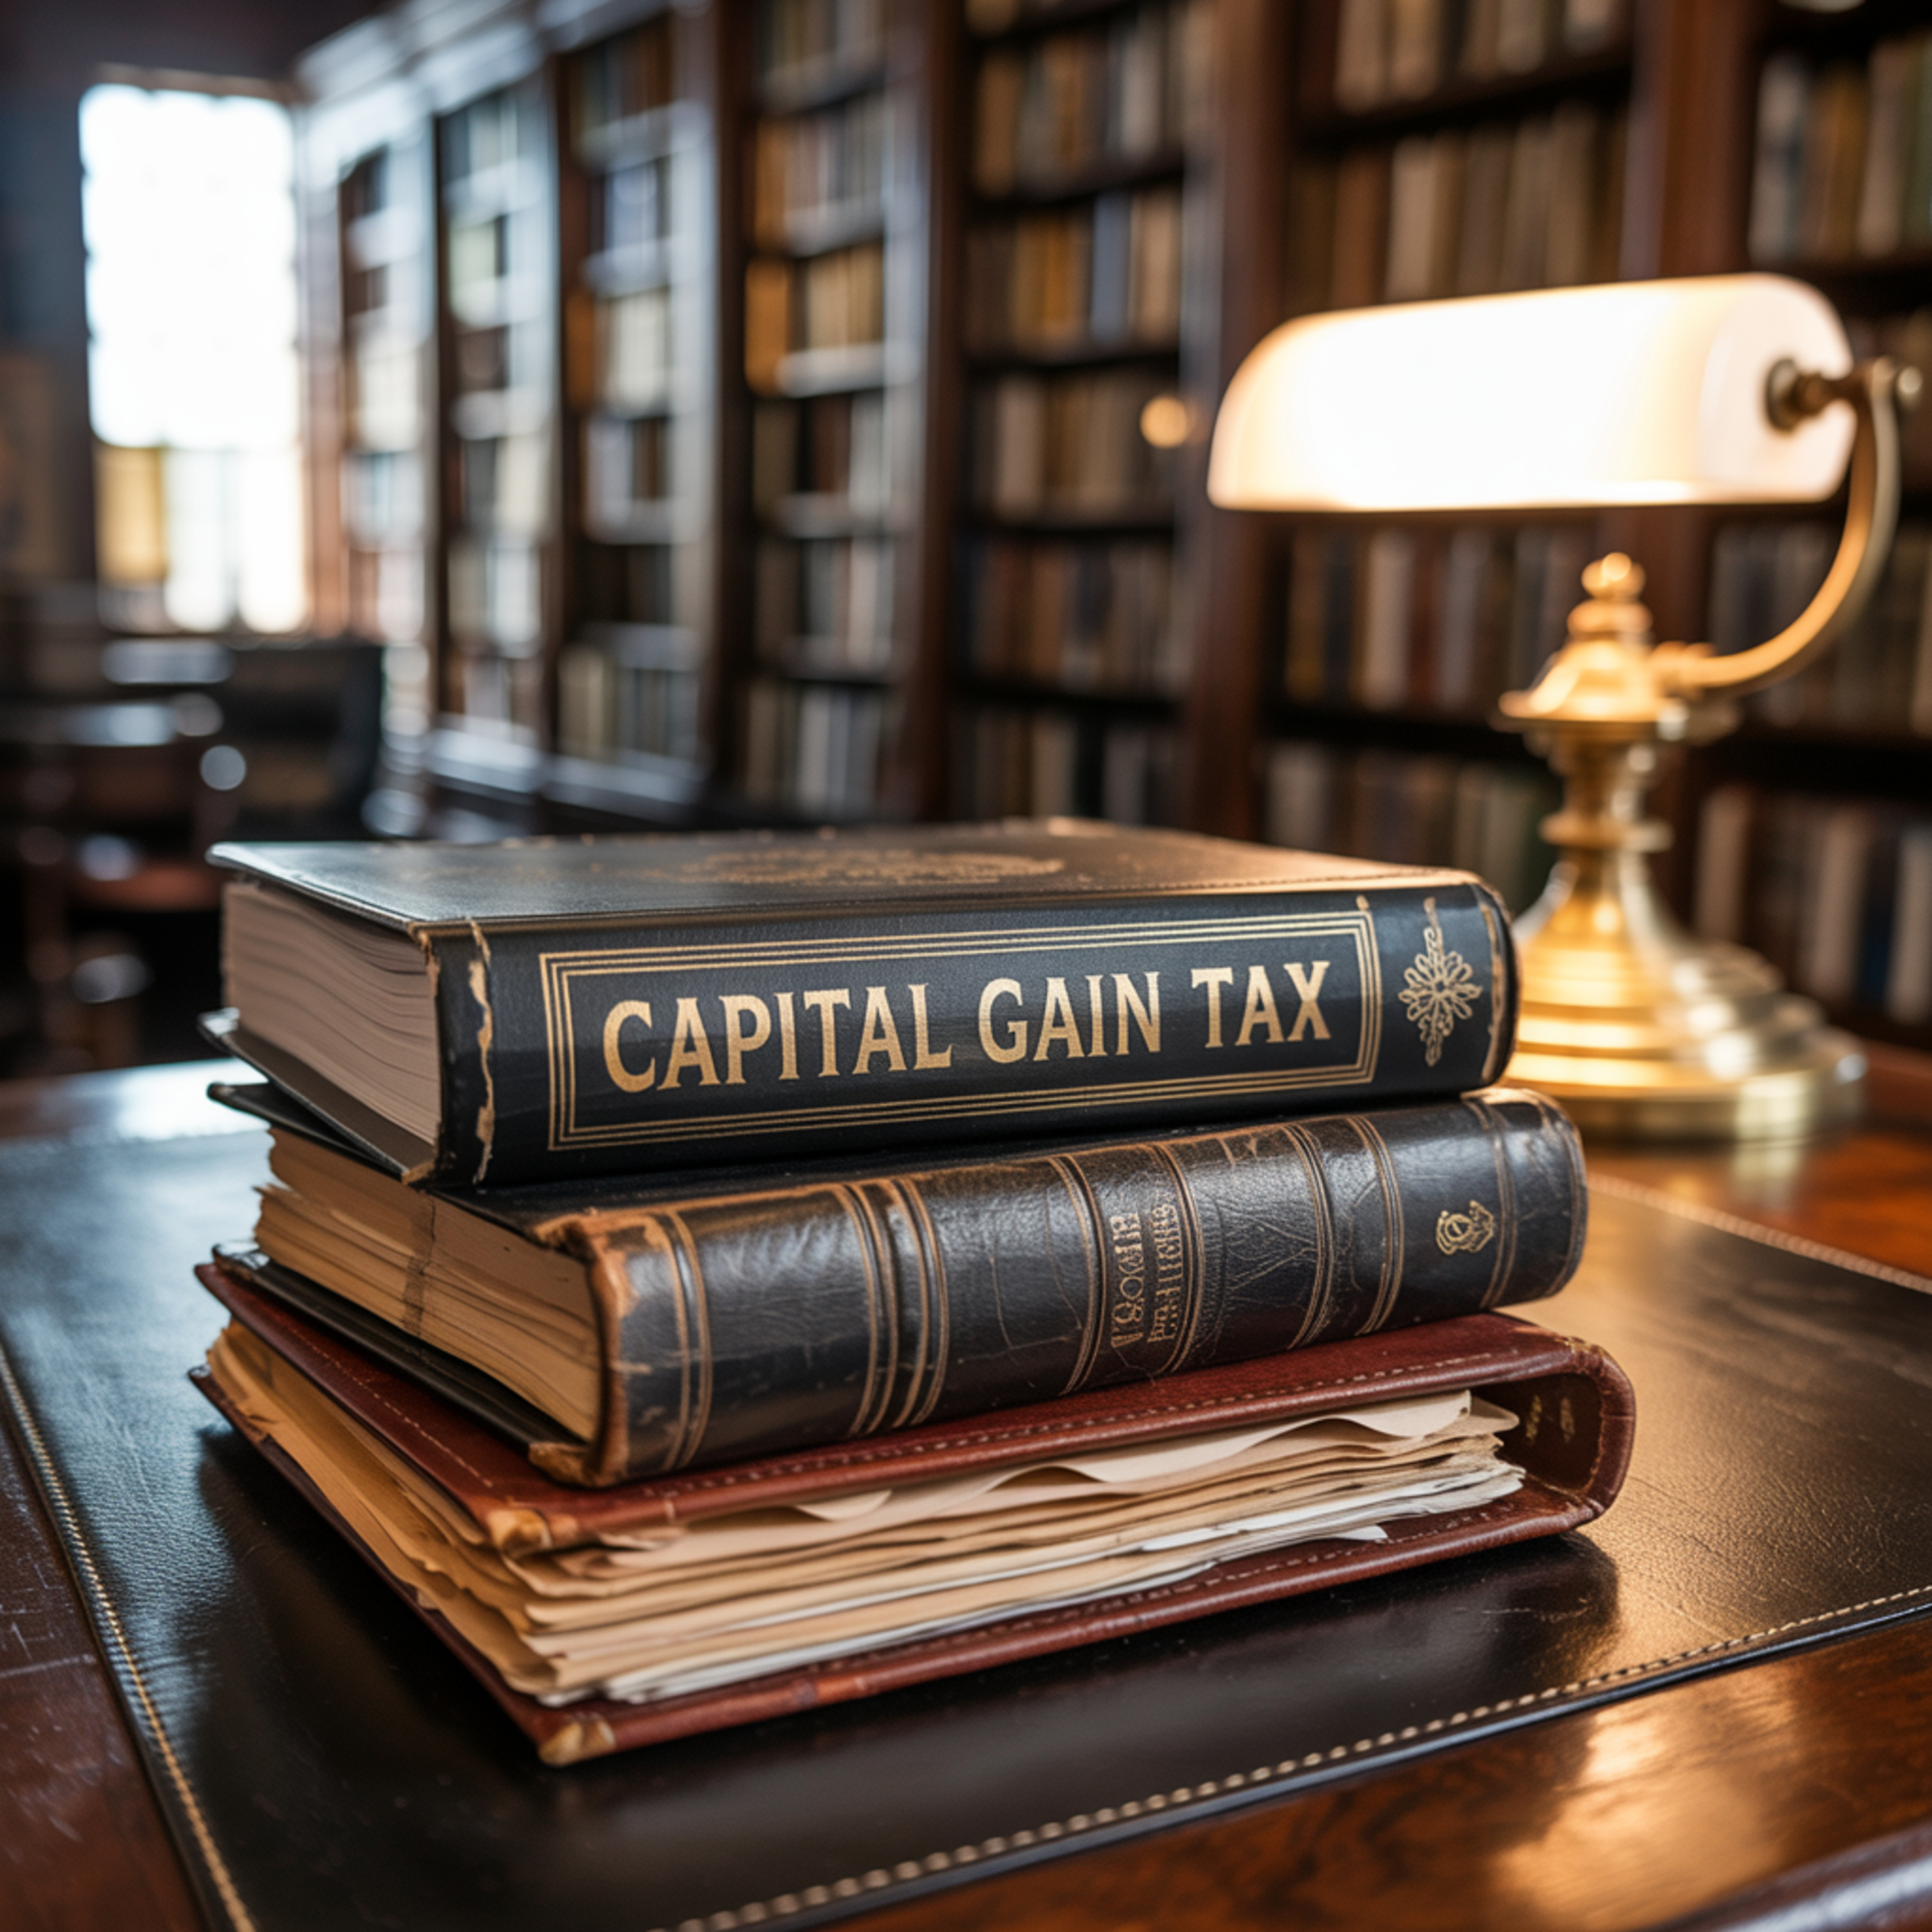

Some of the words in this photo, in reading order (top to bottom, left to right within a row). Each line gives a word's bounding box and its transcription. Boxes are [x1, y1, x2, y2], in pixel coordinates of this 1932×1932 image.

[602, 983, 952, 1092] CAPITAL
[978, 973, 1162, 1064] GAIN
[1191, 960, 1331, 1048] TAX
